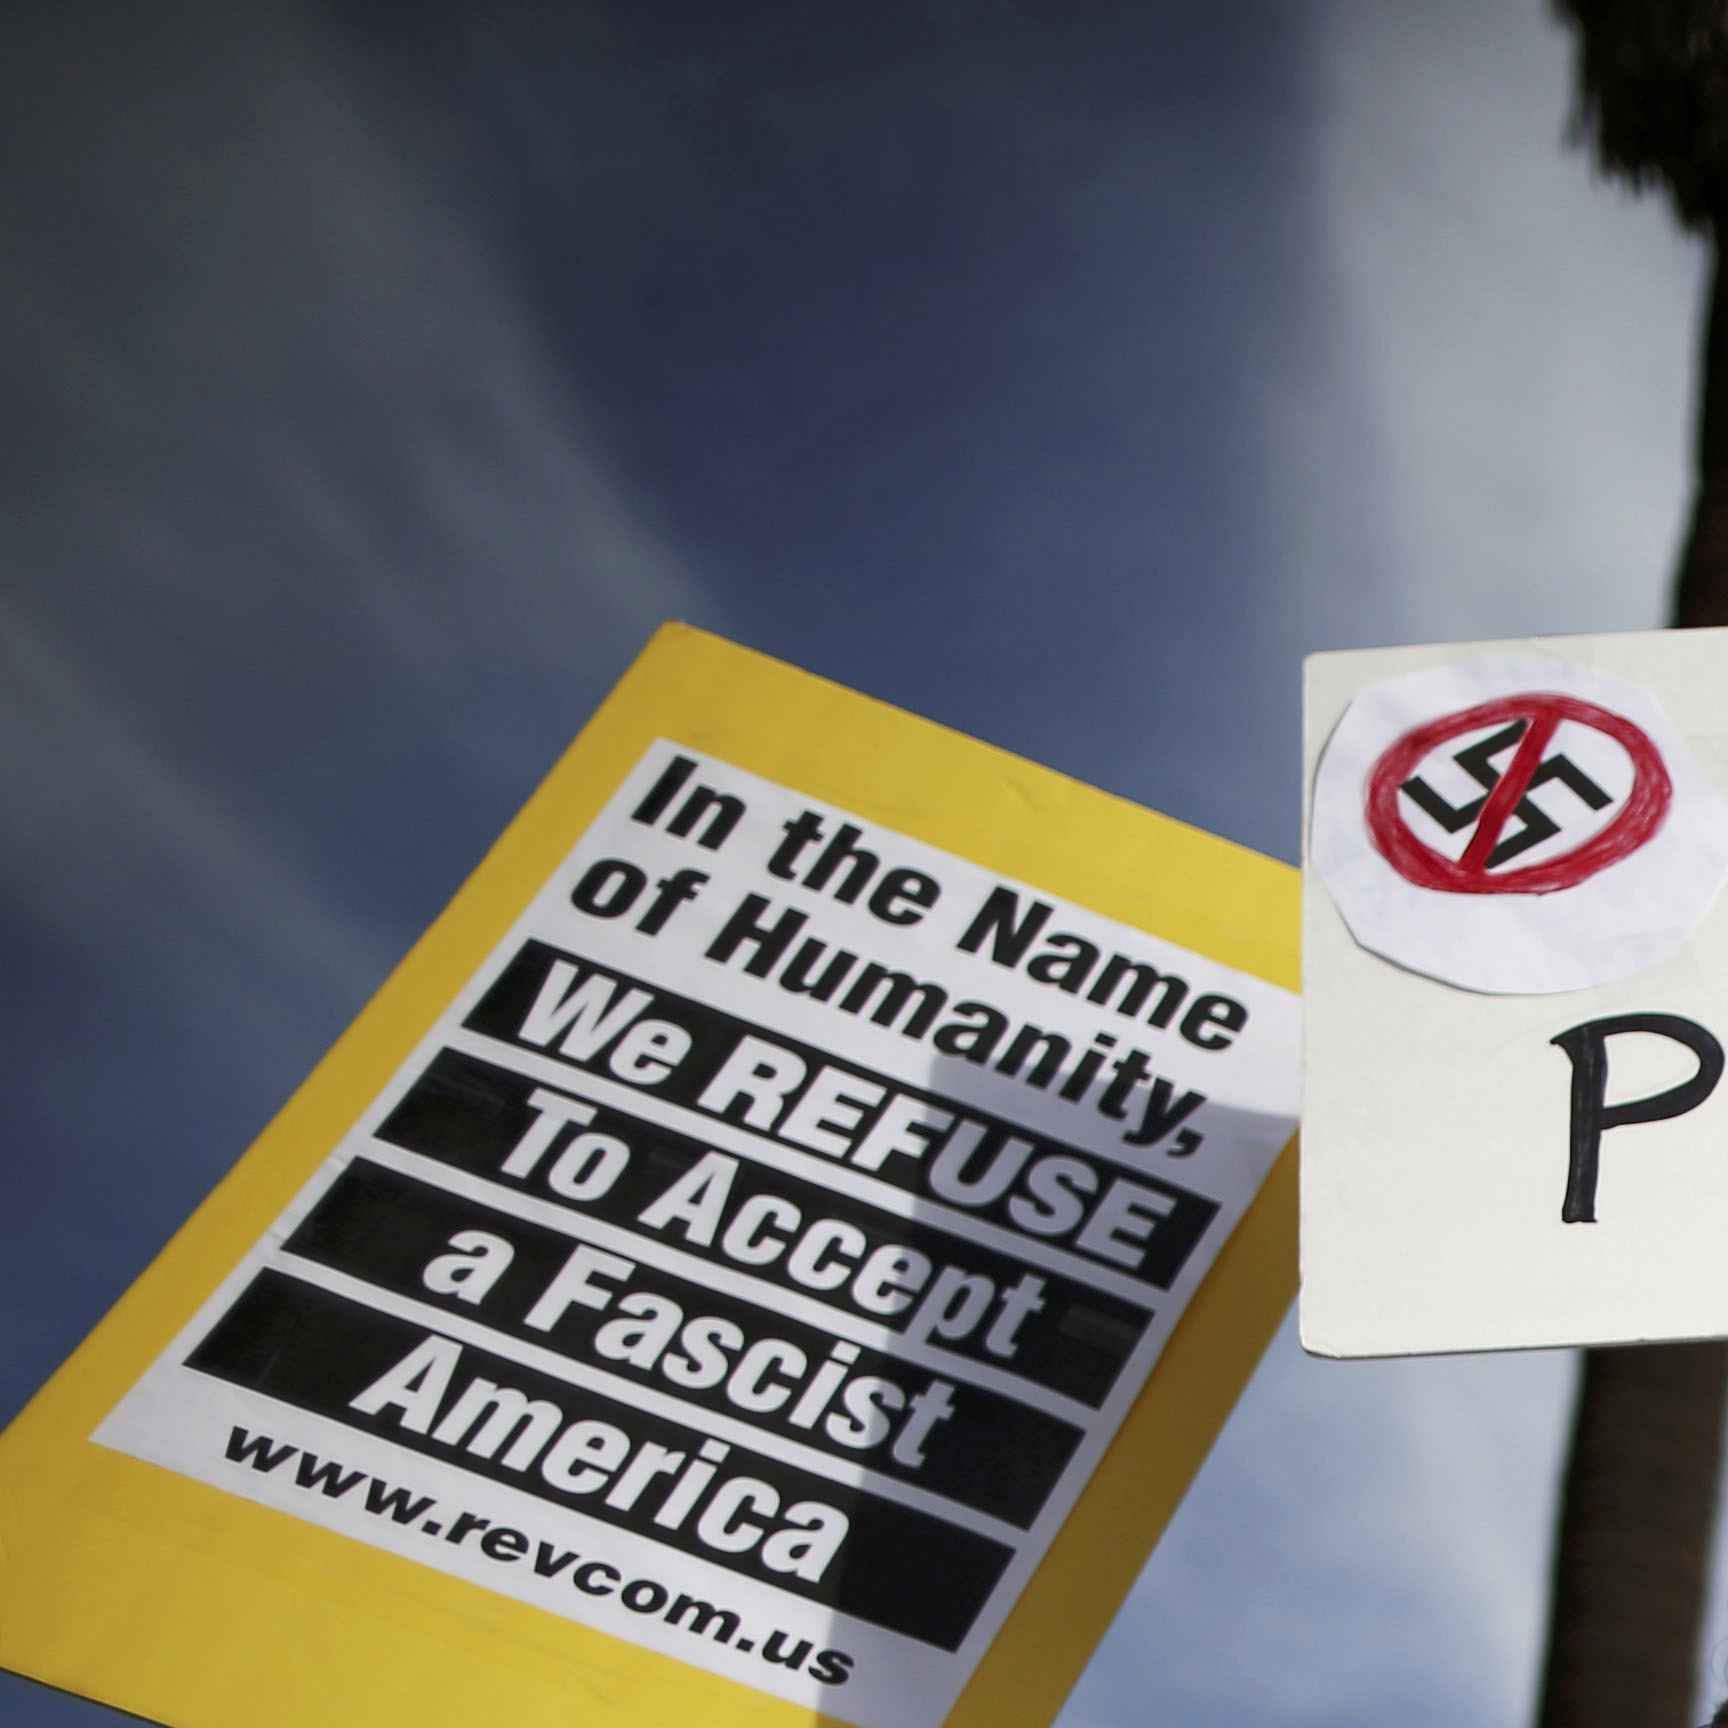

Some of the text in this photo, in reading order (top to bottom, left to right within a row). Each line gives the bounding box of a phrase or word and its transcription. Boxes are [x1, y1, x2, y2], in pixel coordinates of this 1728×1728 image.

[570, 858, 1207, 1159] of Humanity,
[631, 756, 1250, 1051] In the Name
[501, 1093, 1044, 1358] To Accept
[516, 960, 1177, 1268] We REFUSE
[350, 1334, 850, 1586] America
[422, 1229, 955, 1470] a Fascist
[223, 1422, 856, 1687] www.revcom.us
